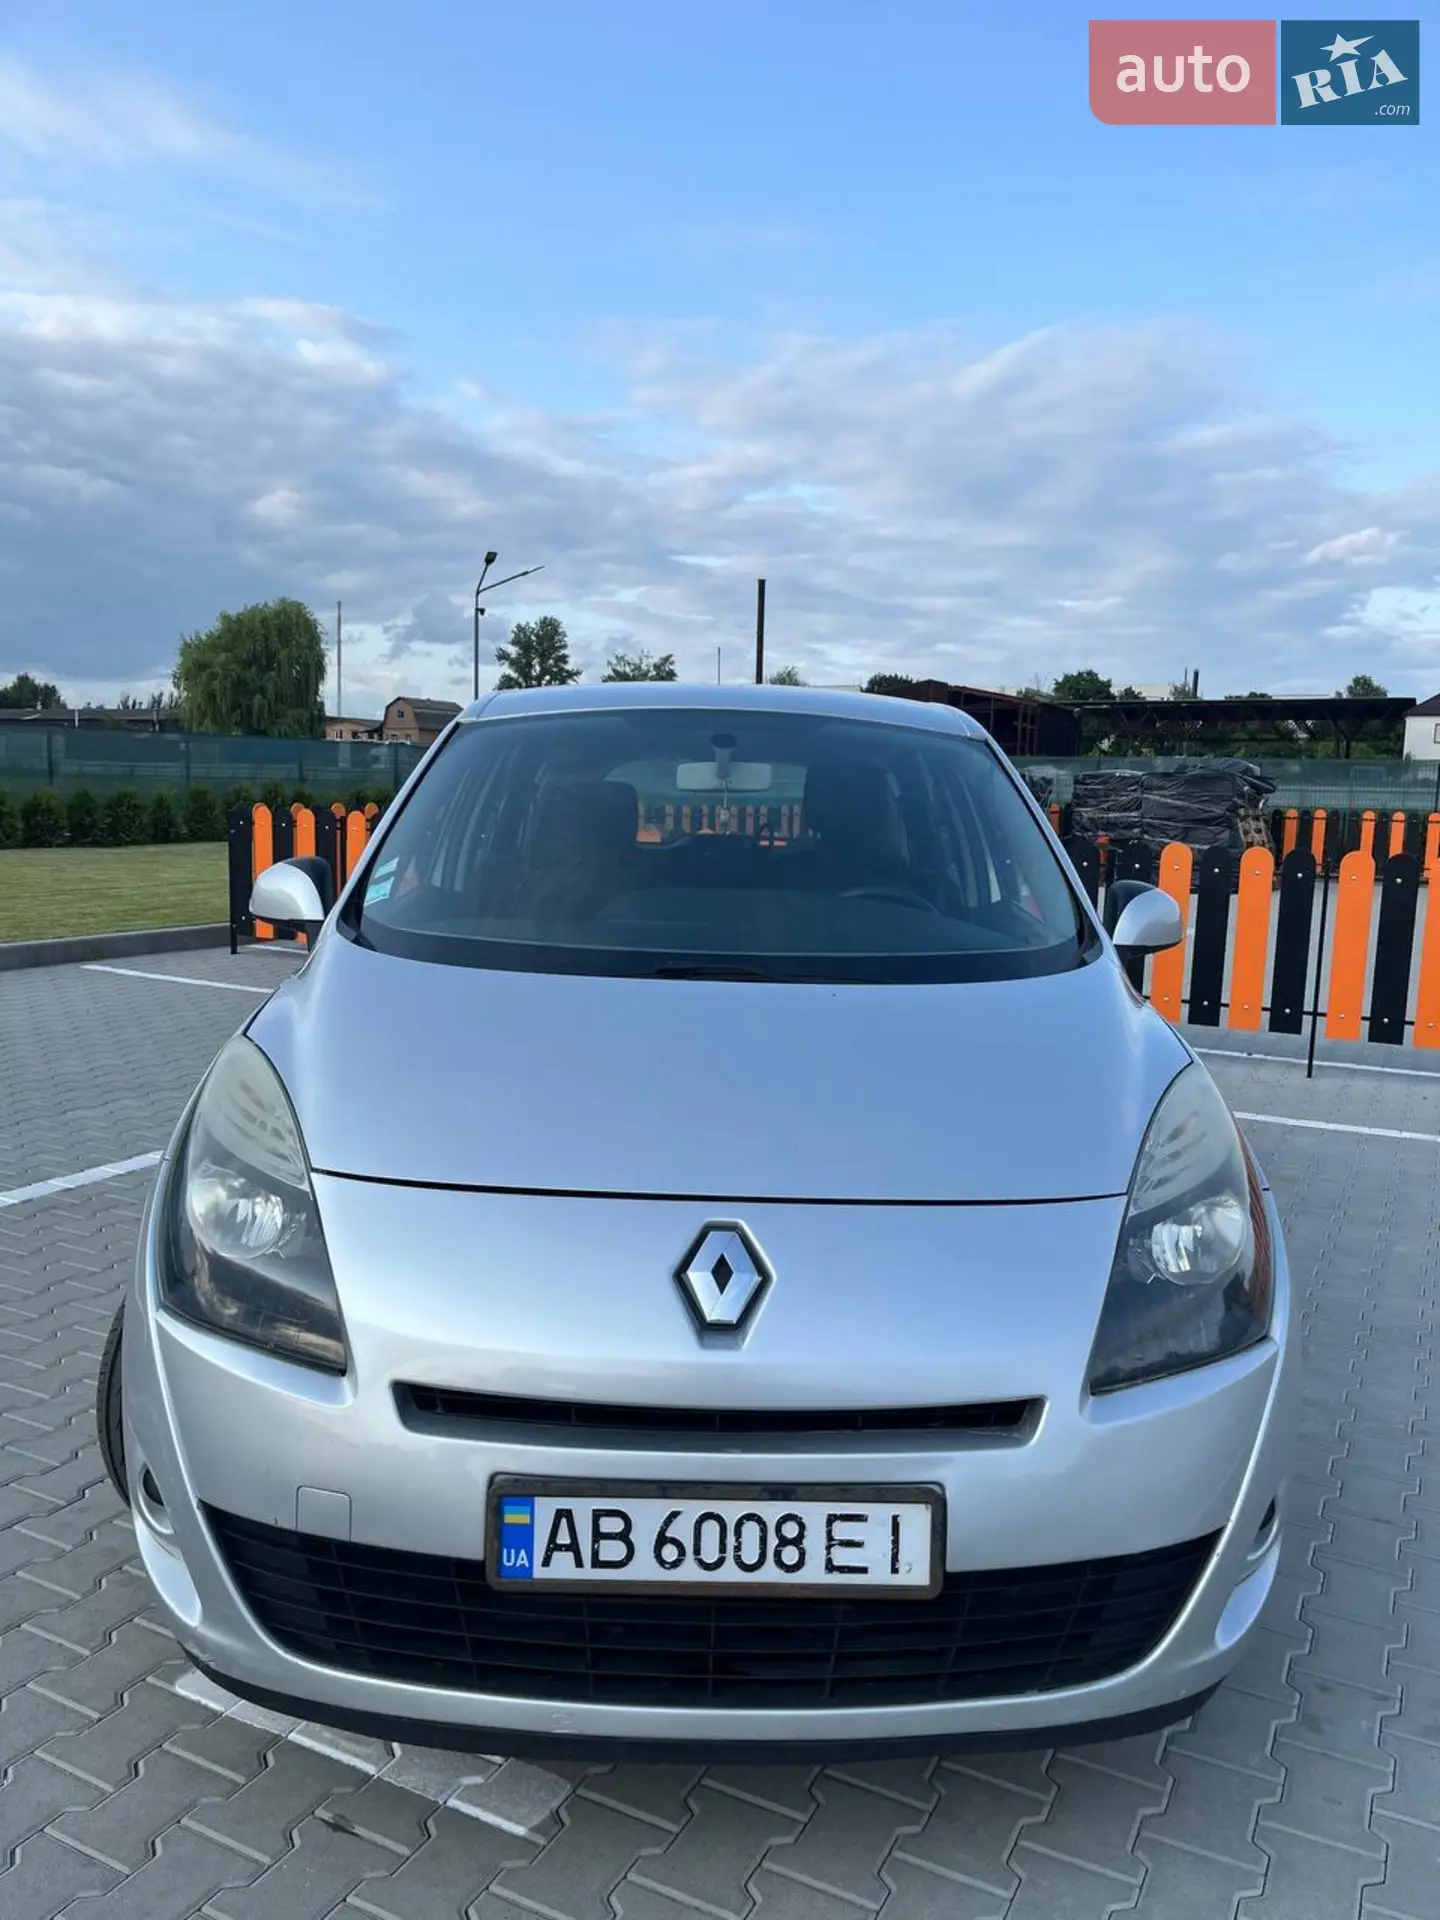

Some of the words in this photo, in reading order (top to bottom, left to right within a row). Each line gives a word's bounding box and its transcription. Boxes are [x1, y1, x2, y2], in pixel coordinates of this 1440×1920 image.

[502, 1547, 530, 1568] UA
[541, 1508, 635, 1569] AB
[653, 1510, 806, 1574] 6008
[824, 1513, 900, 1575] EI
